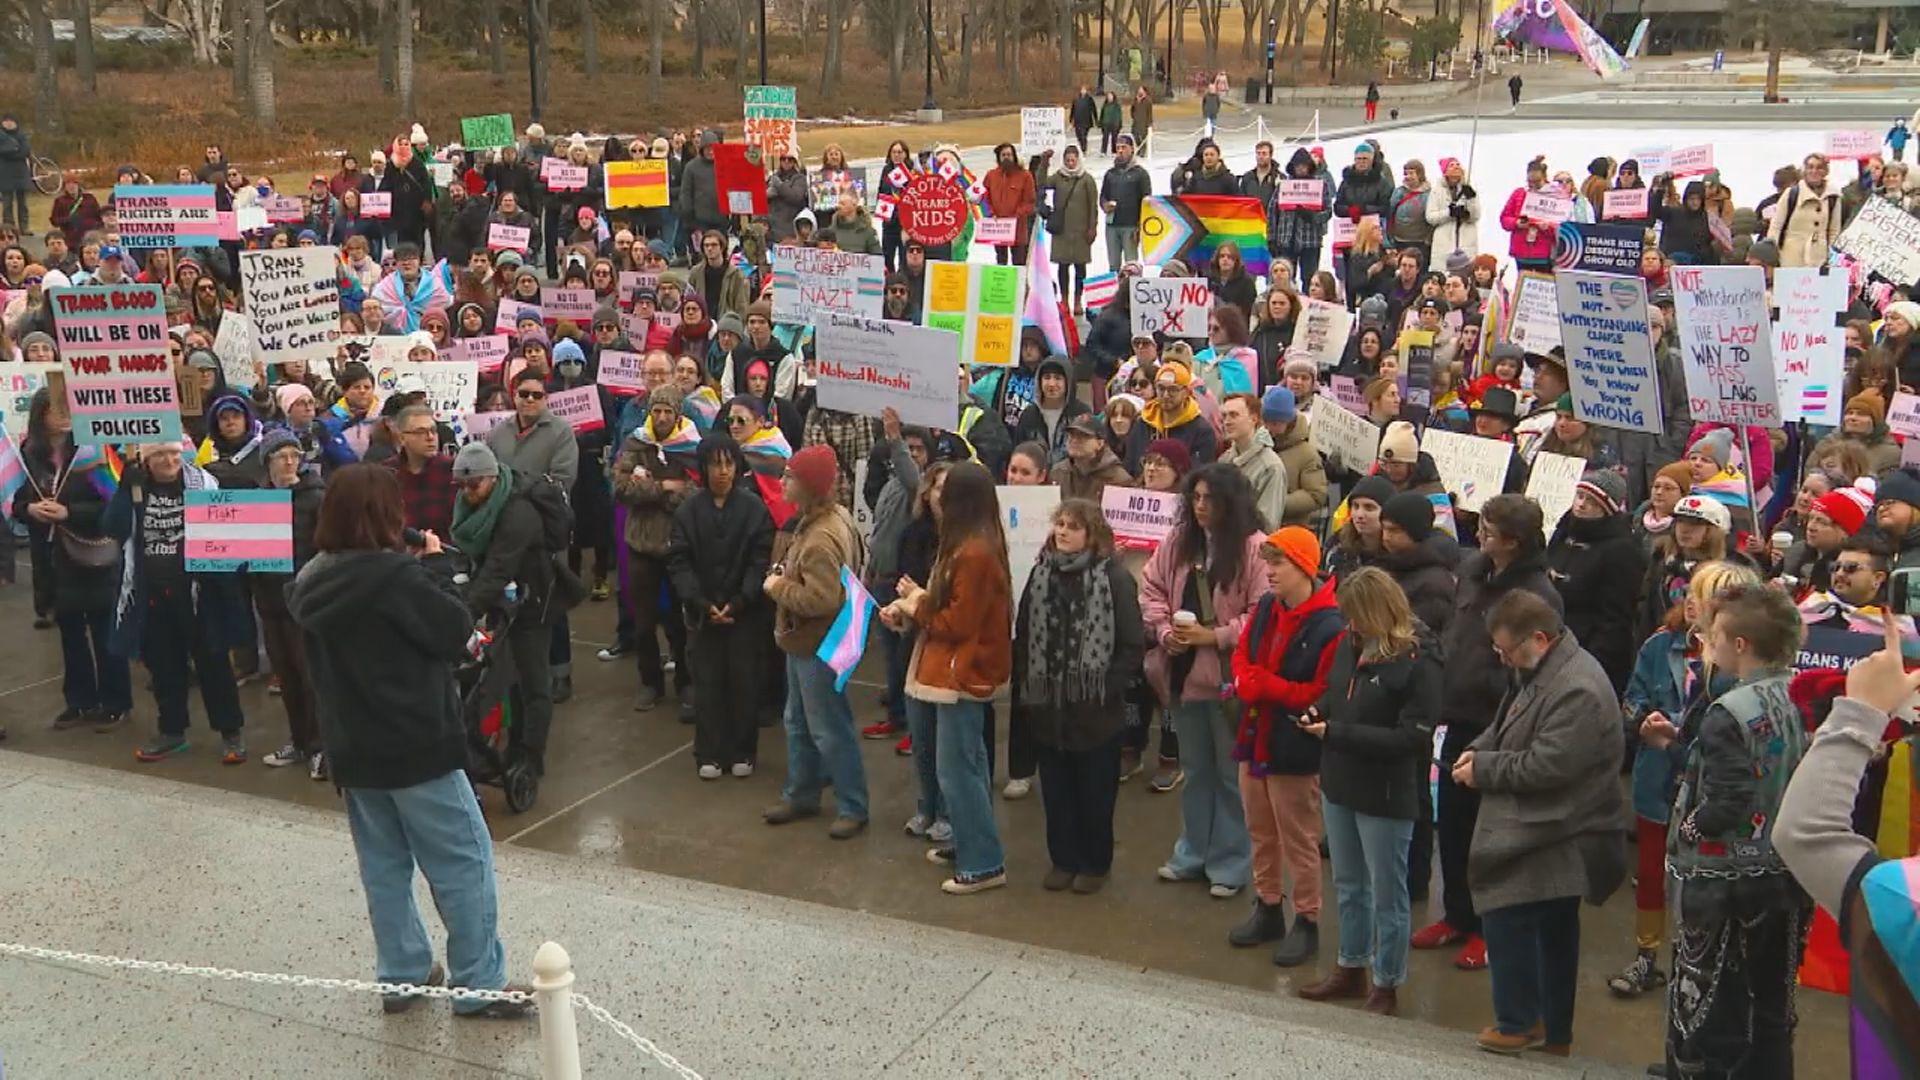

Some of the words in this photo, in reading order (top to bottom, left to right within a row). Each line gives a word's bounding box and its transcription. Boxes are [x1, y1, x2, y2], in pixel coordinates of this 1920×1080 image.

[117, 197, 168, 208] TRANS
[119, 209, 173, 219] RIGHTS
[179, 209, 209, 218] ARE
[912, 210, 957, 227] KIDS
[120, 223, 175, 234] HUMAN
[121, 235, 176, 247] RIGHTS
[1586, 236, 1615, 246] TRANS
[1618, 239, 1640, 248] KIDS
[1584, 247, 1626, 258] DESERVE
[1628, 249, 1640, 258] TO
[1584, 256, 1614, 265] GROW
[1616, 258, 1636, 267] OLD
[242, 253, 305, 272] TRANS
[800, 287, 853, 308] NAZI
[1135, 280, 1173, 311] Say
[1180, 283, 1208, 307] NO
[1576, 281, 1603, 297] THE
[56, 293, 108, 314] TRANS
[110, 290, 157, 310] BLOOD
[1140, 312, 1157, 331] to
[62, 326, 102, 343] WILL
[109, 325, 131, 341] BE
[138, 324, 161, 341] ON
[288, 330, 325, 349] CARE
[1717, 323, 1759, 343] LAZY
[1780, 331, 1798, 352] NO
[69, 355, 112, 376] YOUR
[118, 354, 168, 373] HANDS
[1691, 345, 1722, 368] WAY
[1730, 346, 1750, 363] TO
[1707, 364, 1746, 384] PASS
[74, 389, 117, 406] WITH
[122, 386, 172, 404] THESE
[1720, 384, 1757, 402] LAWS
[1580, 400, 1645, 427] WRONG
[1718, 402, 1776, 419] BETTER
[91, 419, 161, 436] POLICIES
[210, 491, 233, 503] WE
[1128, 495, 1144, 511] NO
[1147, 498, 1161, 512] TO
[207, 505, 242, 521] Fight
[1795, 650, 1840, 669] TRANS
